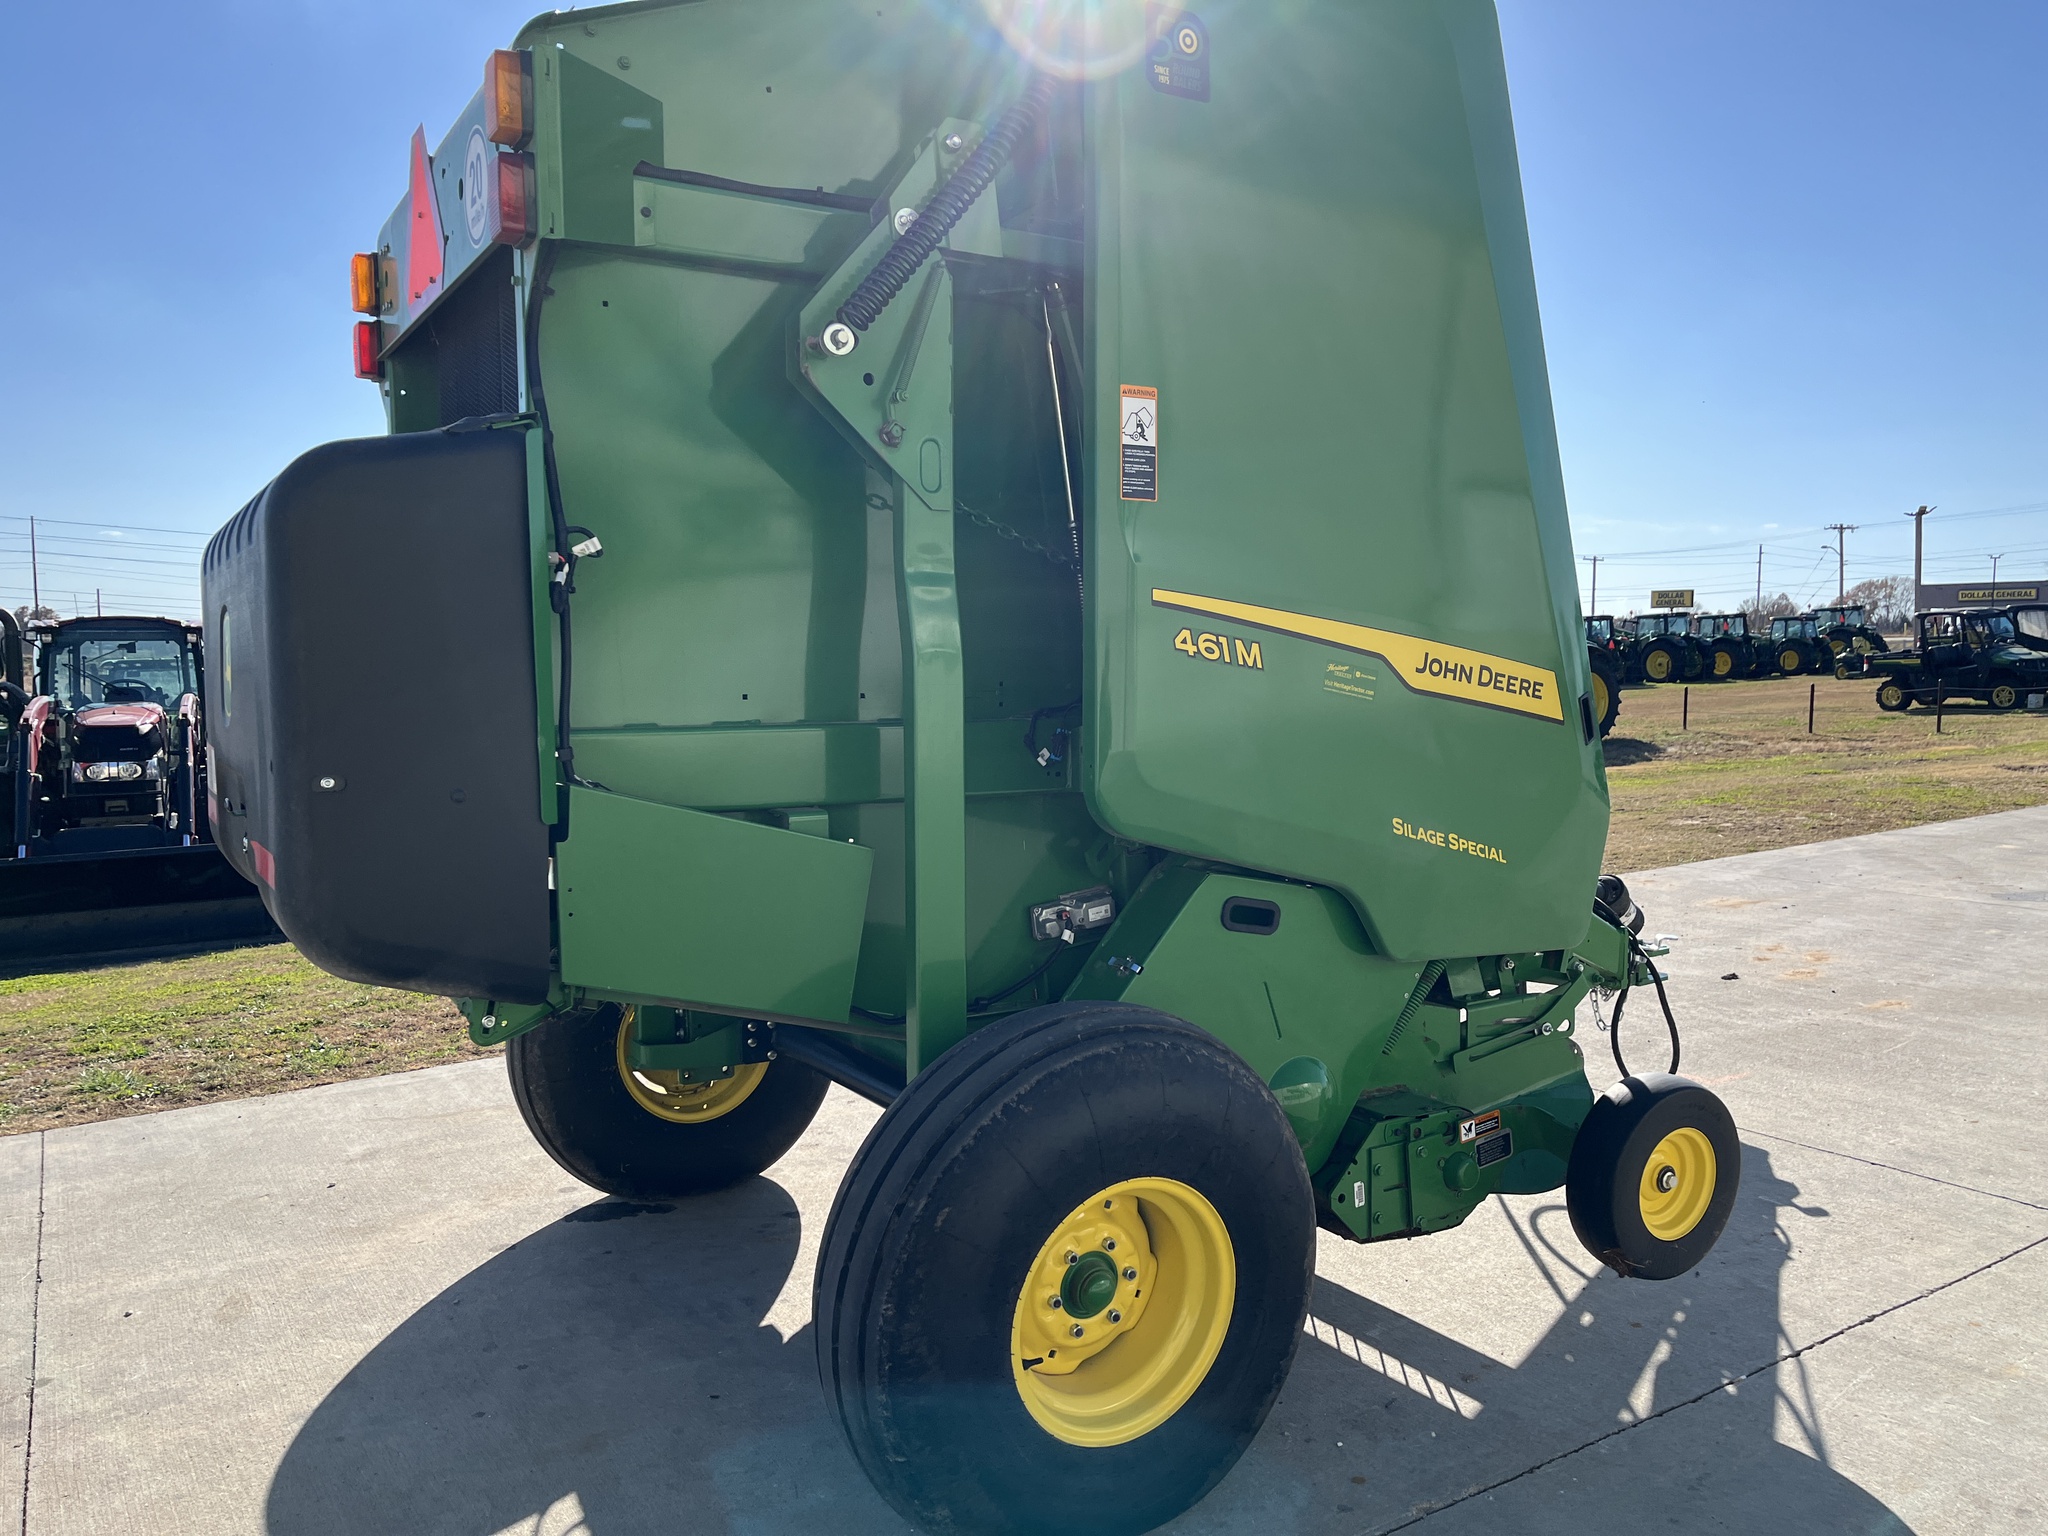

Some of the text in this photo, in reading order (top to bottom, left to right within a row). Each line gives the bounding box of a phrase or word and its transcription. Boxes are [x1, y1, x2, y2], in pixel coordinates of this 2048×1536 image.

[1153, 64, 1170, 76] SINCE
[1172, 63, 1201, 79] ROUND
[1158, 74, 1170, 85] 1975
[469, 153, 482, 208] 20
[1126, 389, 1155, 397] WARNING
[1415, 652, 1544, 700] JOHN DEERE
[1392, 817, 1507, 864] SILAGE SPECIAL
